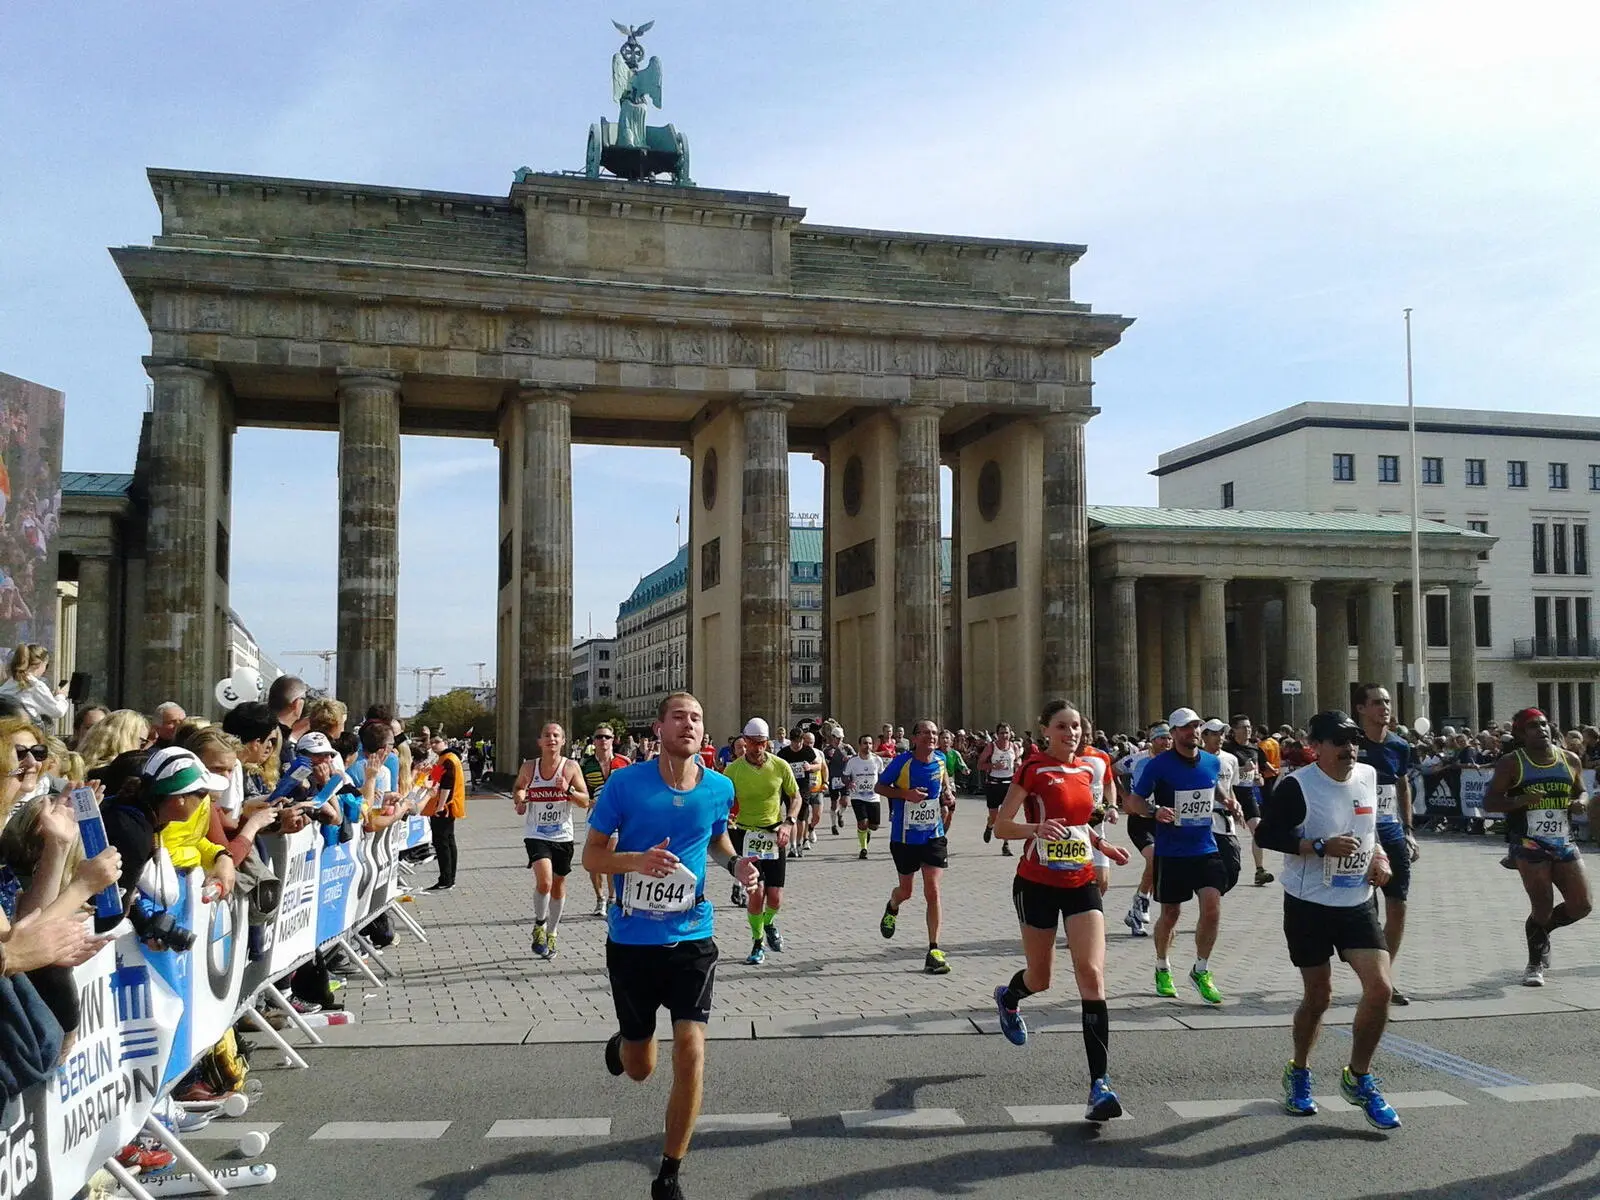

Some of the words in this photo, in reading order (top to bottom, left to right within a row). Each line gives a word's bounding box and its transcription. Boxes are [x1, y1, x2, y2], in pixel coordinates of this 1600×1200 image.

[1181, 801, 1211, 814] 24973
[538, 811, 562, 821] 14901
[910, 809, 936, 820] 12603
[1536, 821, 1562, 832] 7931
[1047, 842, 1086, 858] F8466
[636, 880, 685, 903] 11644
[78, 976, 104, 1041] MW
